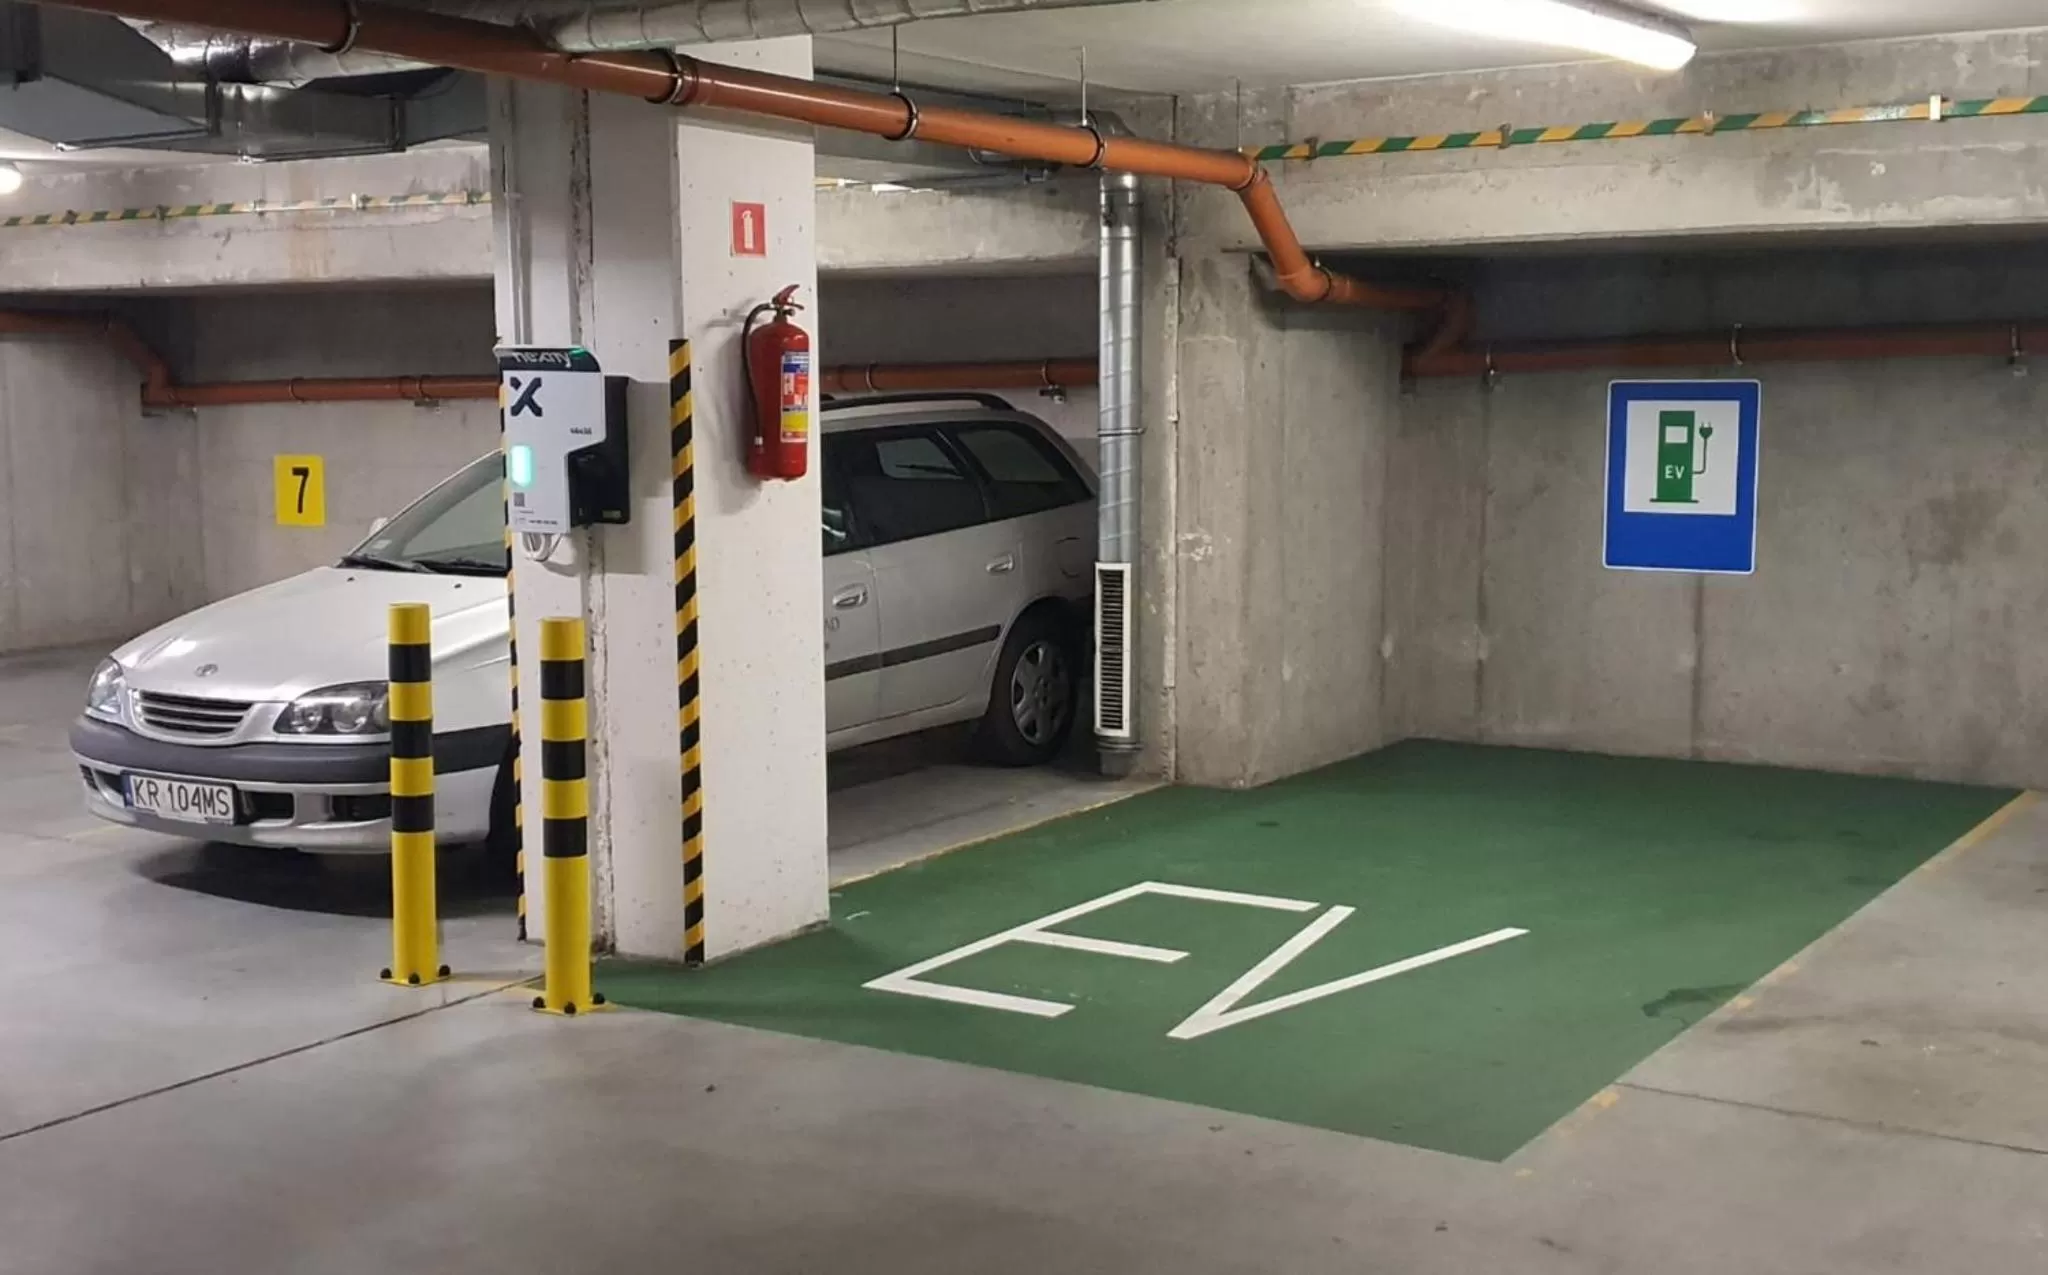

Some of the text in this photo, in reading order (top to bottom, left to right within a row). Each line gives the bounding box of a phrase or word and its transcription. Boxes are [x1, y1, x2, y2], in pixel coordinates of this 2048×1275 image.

[292, 466, 309, 514] 7
[1665, 464, 1686, 479] EV
[134, 779, 230, 817] KR 104MS
[861, 881, 1530, 1041] EV
